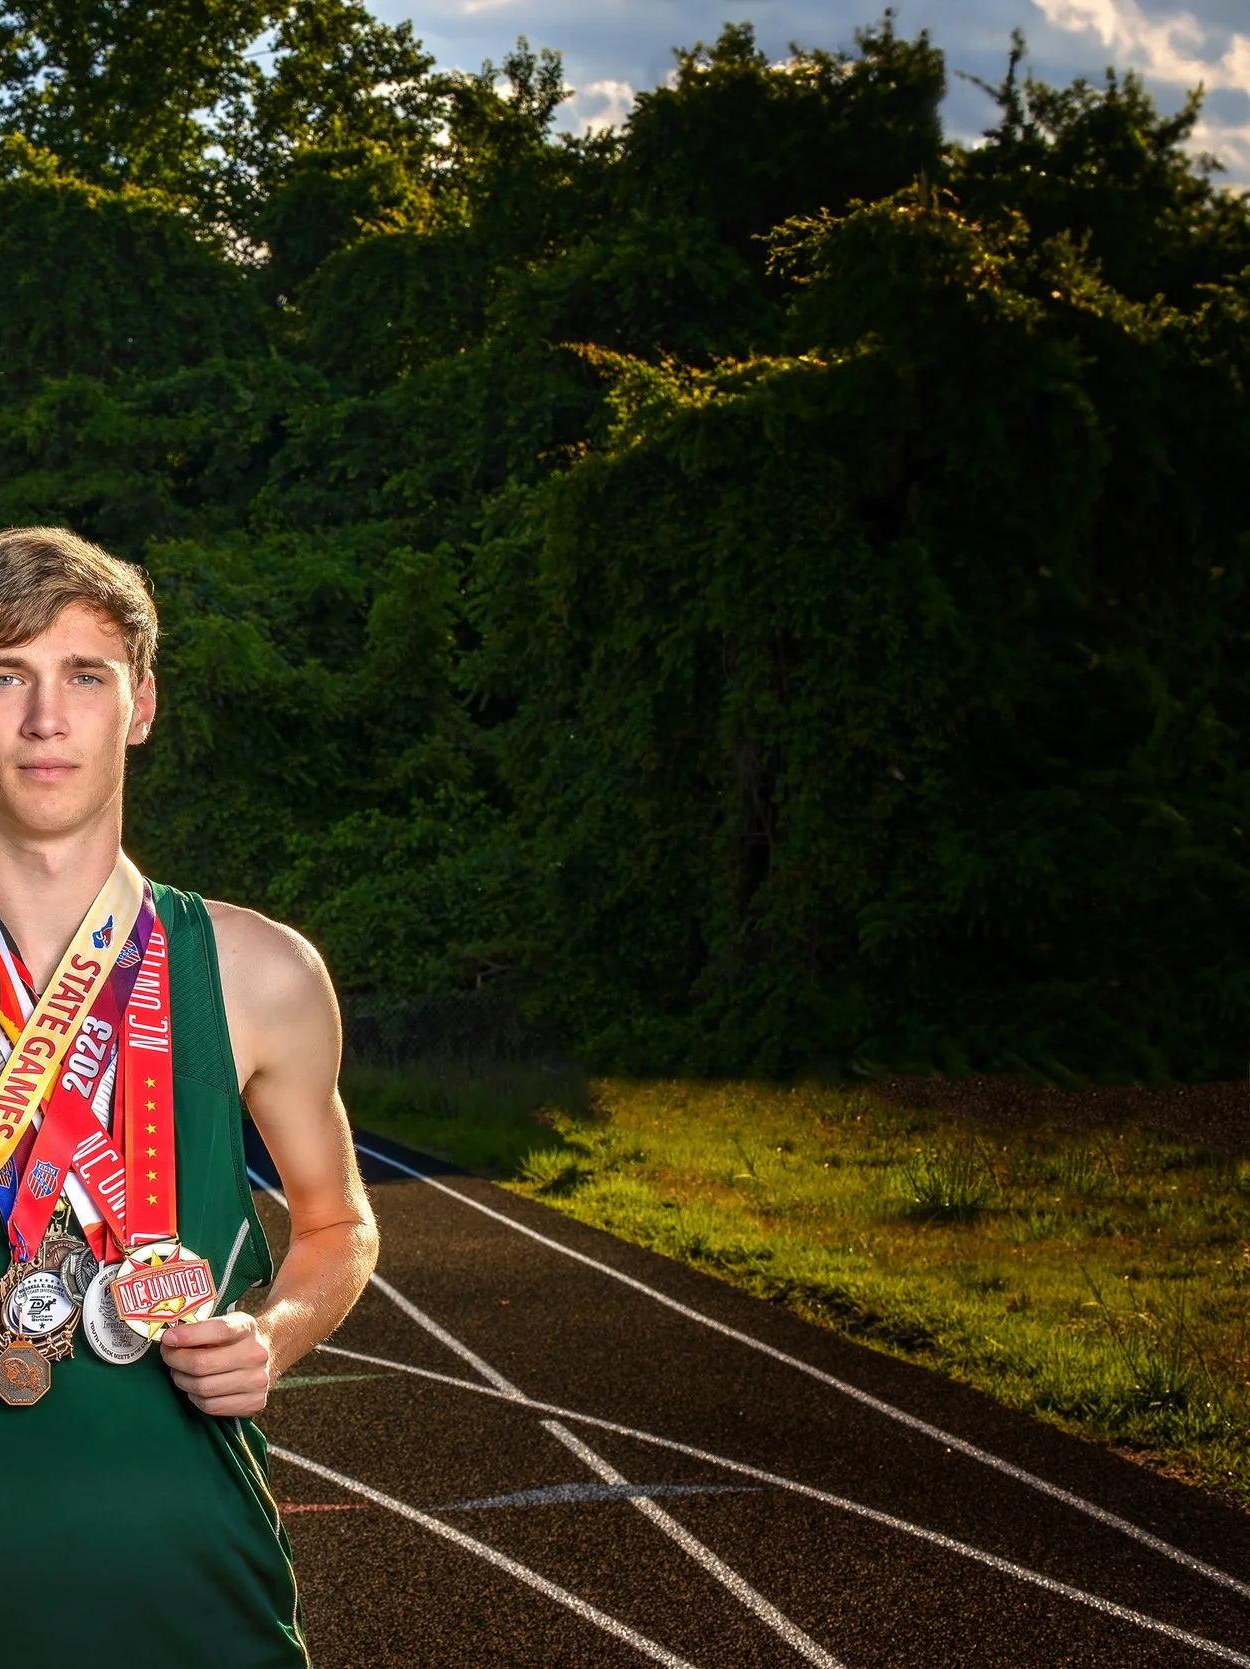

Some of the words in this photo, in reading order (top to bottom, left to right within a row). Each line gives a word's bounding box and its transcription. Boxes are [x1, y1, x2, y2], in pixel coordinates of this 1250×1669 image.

[36, 953, 102, 1036] STATE
[128, 1015, 169, 1053] N.C.
[61, 1015, 113, 1100] 2023
[119, 1280, 153, 1313] N.C.
[147, 1268, 211, 1302] UNITED
[89, 1320, 100, 1343] YOUTH
[99, 1341, 114, 1358] TRACK
